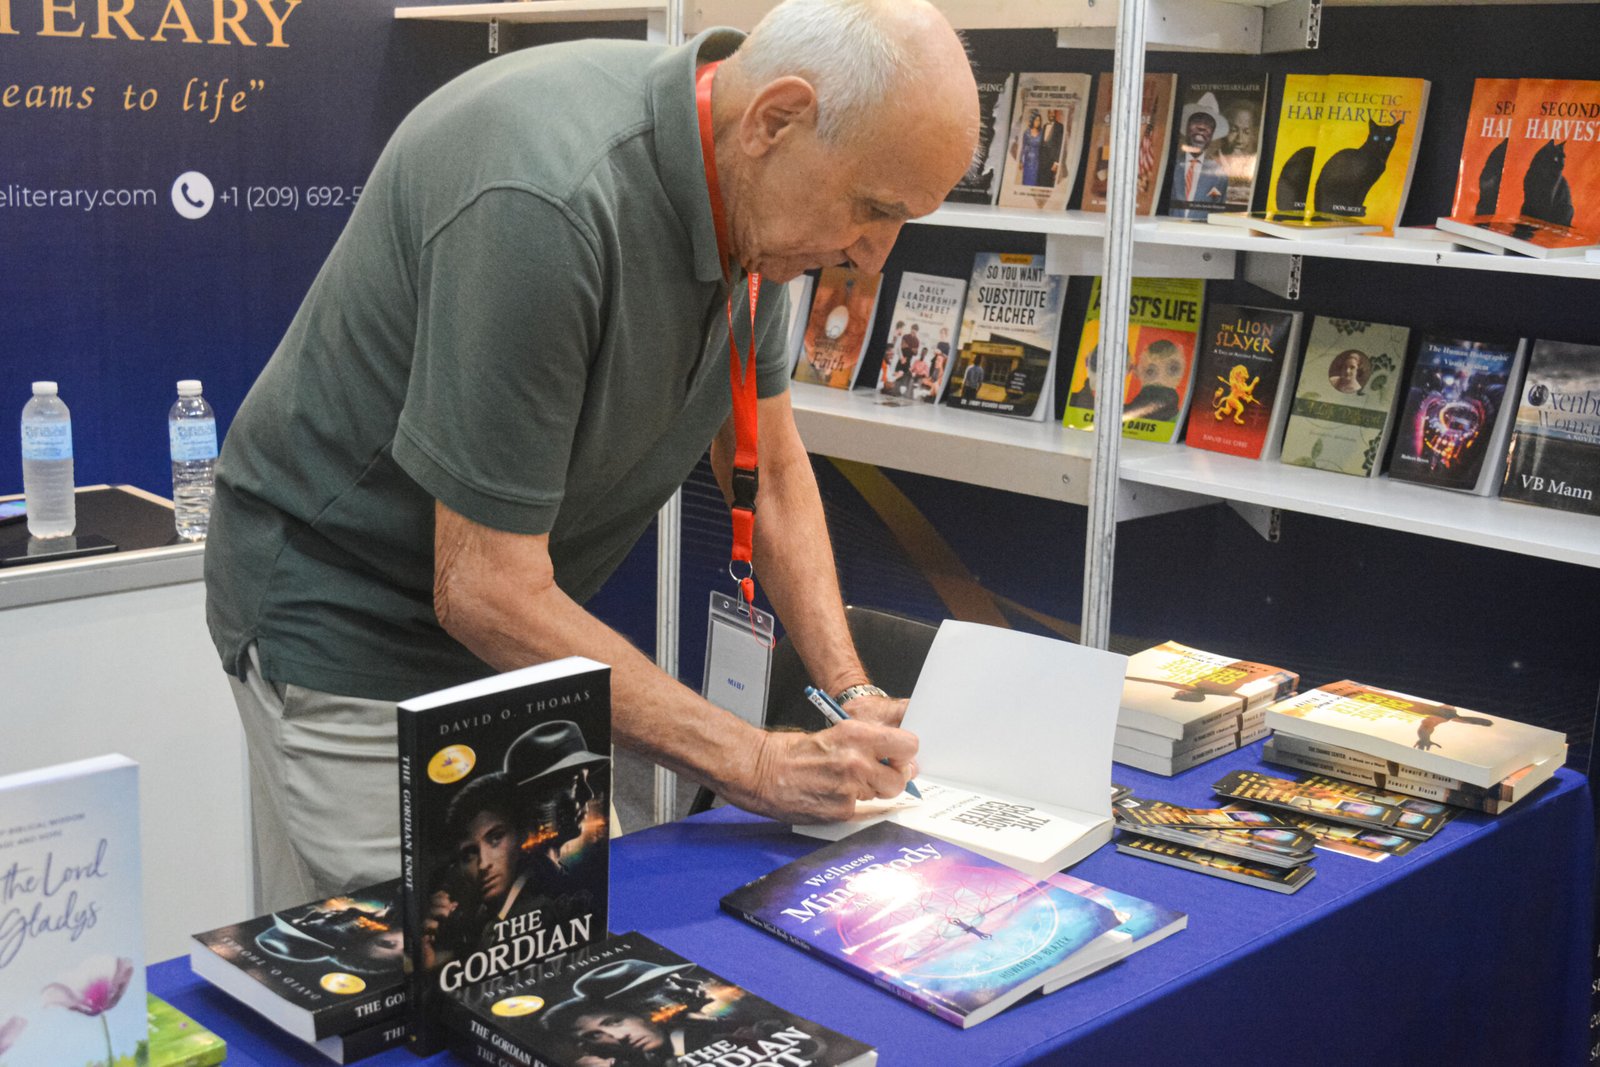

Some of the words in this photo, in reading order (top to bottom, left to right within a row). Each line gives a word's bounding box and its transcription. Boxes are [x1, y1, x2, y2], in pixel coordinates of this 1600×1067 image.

[123, 84, 158, 111] to
[1337, 92, 1403, 106] ECLECTIC
[1540, 102, 1600, 118] SECOND
[1328, 106, 1411, 124] HARVEST
[1524, 118, 1600, 143] HARVES
[220, 187, 239, 207] +1
[247, 186, 299, 211] (209)
[986, 265, 999, 279] SO
[1001, 266, 1018, 281] YOU
[1020, 267, 1044, 282] WANT
[902, 291, 957, 306] LEADERSHIP
[919, 284, 945, 296] DAILY
[977, 286, 1047, 309] SUBSTITUTE
[906, 301, 950, 315] ALPHABET
[983, 305, 1036, 326] TEACHER
[1163, 298, 1197, 323] LIFE
[1236, 318, 1275, 337] LION
[1215, 331, 1275, 354] SLAYER
[1429, 344, 1441, 353] The
[1128, 422, 1157, 433] DAVIS
[1521, 473, 1545, 492] VB
[1547, 479, 1593, 501] Mann
[439, 713, 492, 736] DAVID
[501, 709, 517, 720] O.
[526, 690, 591, 714] THOMAS
[402, 755, 411, 785] THE
[403, 789, 412, 850] GORDIAN
[43, 838, 108, 897] Lord
[404, 854, 414, 891] KNOT
[804, 853, 875, 888] Wellness
[0, 890, 99, 969] Gladys
[494, 909, 542, 942] THE
[439, 913, 593, 993] GORDIAN
[483, 978, 536, 999] DAVID
[568, 943, 632, 971] THOMAS
[283, 977, 321, 1000] DAVID
[354, 1000, 382, 1017] THE
[471, 1020, 490, 1039] THE
[491, 1033, 532, 1065] GORDIAN
[677, 1040, 737, 1067] THE
[697, 1026, 812, 1067] DIAN
